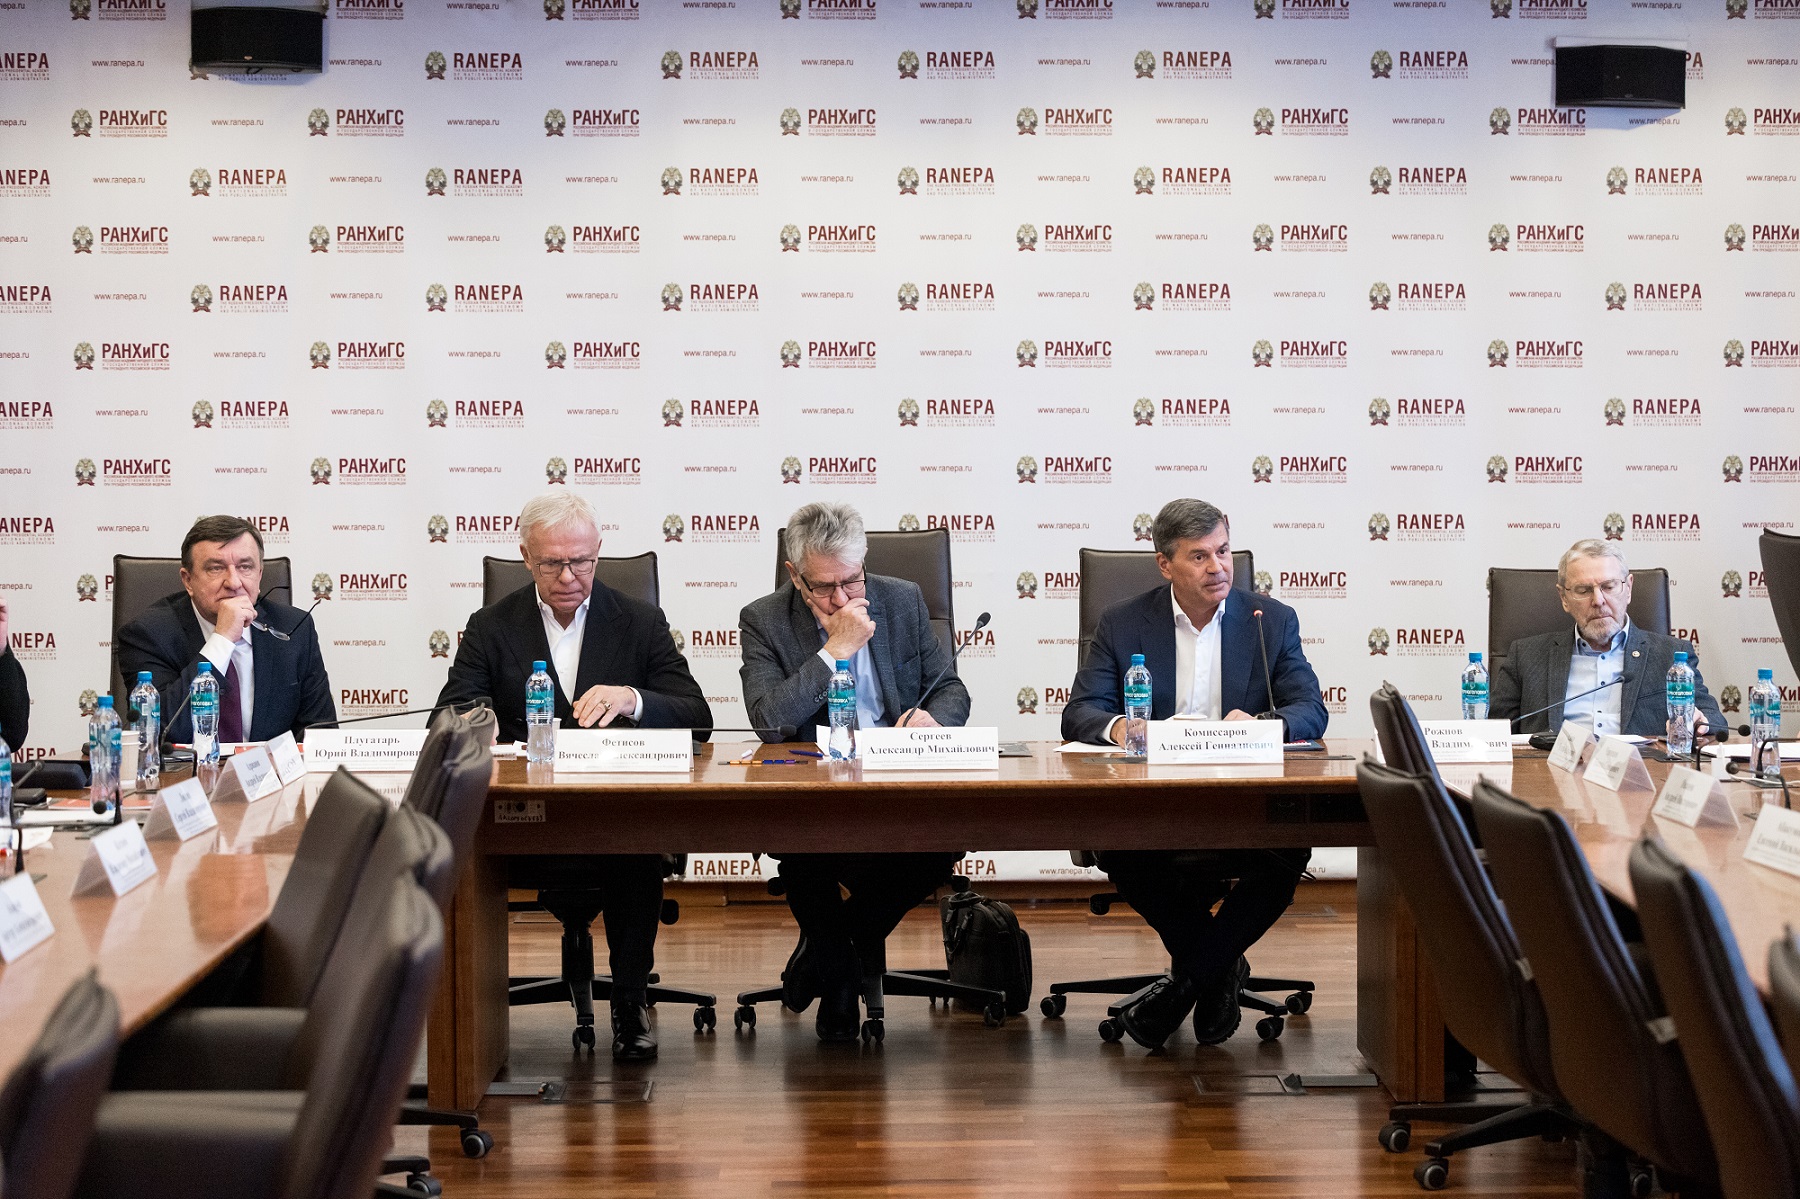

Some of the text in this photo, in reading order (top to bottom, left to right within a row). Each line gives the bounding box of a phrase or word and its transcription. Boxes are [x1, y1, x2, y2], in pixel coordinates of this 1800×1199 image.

[446, 3, 499, 11] www.ranepa.ru
[683, 2, 736, 10] www.ranepa.ru
[919, 2, 974, 10] www.ranepa.ru
[1154, 2, 1209, 10] www.ranepa.ru
[1393, 1, 1446, 9] www.ranepa.ru
[1631, 2, 1682, 10] www.ranepa.ru
[91, 60, 144, 68] www.ranepa.ru
[329, 59, 382, 67] www.ranepa.ru
[454, 52, 522, 67] RANEPA
[565, 60, 618, 68] www.ranepa.ru
[690, 51, 759, 67] RANEPA
[801, 59, 854, 67] www.ranepa.ru
[927, 51, 995, 67] RANEPA
[1038, 59, 1090, 67] www.ranepa.ru
[1163, 51, 1232, 67] RANEPA
[1274, 59, 1327, 67] www.ranepa.ru
[1400, 51, 1468, 67] RANEPA
[1747, 59, 1798, 67] www.ranepa.ru
[100, 111, 168, 126] РАНХиГС
[336, 110, 404, 126] РАНХиГС
[572, 110, 641, 125] РАНХиГС
[683, 118, 735, 126] www.ranepa.ru
[809, 109, 877, 125] РАНХиГС
[920, 118, 972, 126] www.ranepa.ru
[1045, 109, 1113, 125] РАНХиГС
[1156, 118, 1208, 126] www.ranepa.ru
[1281, 109, 1349, 125] РАНХиГС
[1392, 118, 1445, 126] www.ranepa.ru
[1517, 109, 1586, 125] РАНХиГС
[1628, 118, 1680, 126] www.ranepa.ru
[211, 119, 264, 127] www.ranepa.ru
[447, 119, 499, 127] www.ranepa.ru
[218, 169, 286, 184] RANEPA
[330, 176, 382, 184] www.ranepa.ru
[454, 168, 523, 184] RANEPA
[566, 176, 618, 184] www.ranepa.ru
[691, 168, 759, 183] RANEPA
[801, 175, 853, 183] www.ranepa.ru
[927, 167, 995, 183] RANEPA
[1038, 175, 1090, 183] www.ranepa.ru
[1163, 167, 1231, 183] RANEPA
[1274, 175, 1326, 183] www.ranepa.ru
[1399, 167, 1467, 183] RANEPA
[1510, 175, 1562, 183] www.ranepa.ru
[1635, 167, 1703, 183] RANEPA
[1746, 175, 1796, 183] www.ranepa.ru
[93, 177, 145, 185] www.ranepa.ru
[101, 227, 169, 242] РАНХиГС
[337, 227, 405, 242] РАНХиГС
[573, 226, 641, 242] РАНХиГС
[809, 226, 877, 241] РАНХиГС
[920, 234, 971, 242] www.ranepa.ru
[1045, 225, 1113, 241] РАНХиГС
[1281, 225, 1349, 241] РАНХиГС
[1392, 233, 1444, 241] www.ranepa.ru
[1516, 225, 1585, 241] РАНХиГС
[1628, 234, 1679, 242] www.ranepa.ru
[448, 235, 500, 243] www.ranepa.ru
[219, 285, 287, 300] RANEPA
[330, 292, 383, 300] www.ranepa.ru
[455, 284, 523, 300] RANEPA
[691, 284, 759, 299] RANEPA
[801, 292, 853, 300] www.ranepa.ru
[927, 283, 994, 299] RANEPA
[1162, 283, 1230, 299] RANEPA
[1273, 291, 1325, 299] www.ranepa.ru
[1398, 283, 1466, 299] RANEPA
[1634, 283, 1702, 299] RANEPA
[1745, 291, 1795, 299] www.ranepa.ru
[102, 343, 170, 359] РАНХиГС
[338, 343, 405, 358] РАНХиГС
[573, 342, 641, 357] РАНХиГС
[684, 350, 736, 358] www.ranepa.ru
[809, 341, 877, 357] РАНХиГС
[1045, 341, 1112, 357] РАНХиГС
[1155, 349, 1207, 357] www.ranepa.ru
[1280, 341, 1348, 357] РАНХиГС
[1516, 341, 1584, 357] РАНХиГС
[1627, 349, 1678, 357] www.ranepa.ru
[214, 351, 266, 359] www.ranepa.ru
[221, 401, 288, 416] RANEPA
[456, 400, 524, 416] RANEPA
[691, 400, 759, 415] RANEPA
[927, 399, 994, 415] RANEPA
[1038, 407, 1089, 415] www.ranepa.ru
[1162, 399, 1230, 414] RANEPA
[1398, 399, 1465, 414] RANEPA
[1508, 407, 1561, 415] www.ranepa.ru
[1633, 398, 1701, 414] RANEPA
[1743, 406, 1794, 414] www.ranepa.ru
[95, 410, 148, 418] www.ranepa.ru
[567, 408, 618, 416] www.ranepa.ru
[104, 459, 171, 475] РАНХиГС
[339, 459, 406, 474] РАНХиГС
[574, 458, 642, 473] РАНХиГС
[809, 457, 877, 473] РАНХиГС
[920, 465, 972, 473] www.ranepa.ru
[1045, 457, 1112, 472] РАНХиГС
[1155, 465, 1207, 473] www.ranepa.ru
[1280, 456, 1347, 472] РАНХиГС
[1390, 464, 1443, 472] www.ranepa.ru
[1515, 456, 1583, 472] РАНХиГС
[1626, 465, 1678, 473] www.ranepa.ru
[215, 467, 267, 475] www.ranepa.ru
[449, 466, 501, 474] www.ranepa.ru
[684, 466, 736, 474] www.ranepa.ru
[692, 515, 760, 531] RANEPA
[927, 515, 995, 530] RANEPA
[1273, 522, 1324, 530] www.ranepa.ru
[1397, 514, 1465, 529] RANEPA
[1507, 522, 1560, 530] www.ranepa.ru
[1632, 514, 1700, 529] RANEPA
[1742, 521, 1793, 529] www.ranepa.ru
[97, 525, 149, 533] www.ranepa.ru
[332, 524, 385, 532] www.ranepa.ru
[1037, 523, 1089, 531] www.ranepa.ru
[340, 574, 407, 590] РАНХиГС
[1280, 572, 1347, 587] РАНХиГС
[1390, 580, 1442, 588] www.ranepa.ru
[685, 581, 737, 589] www.ranepa.ru
[1397, 629, 1465, 645] RANEPA
[333, 640, 386, 648] www.ranepa.ru
[341, 690, 409, 705] РАНХиГС
[910, 731, 952, 742] Сергеев
[1184, 728, 1248, 738] Комиссаров
[1424, 727, 1463, 736] Рожнов
[344, 736, 400, 746] Плугатарь
[602, 738, 645, 747] Фетисов
[1159, 741, 1202, 751] Алексей
[315, 748, 347, 760] Юрий
[868, 744, 995, 755] Александр Михайлович
[694, 860, 762, 875] RANEPA
[1039, 867, 1092, 876] www.ranepa.ru
